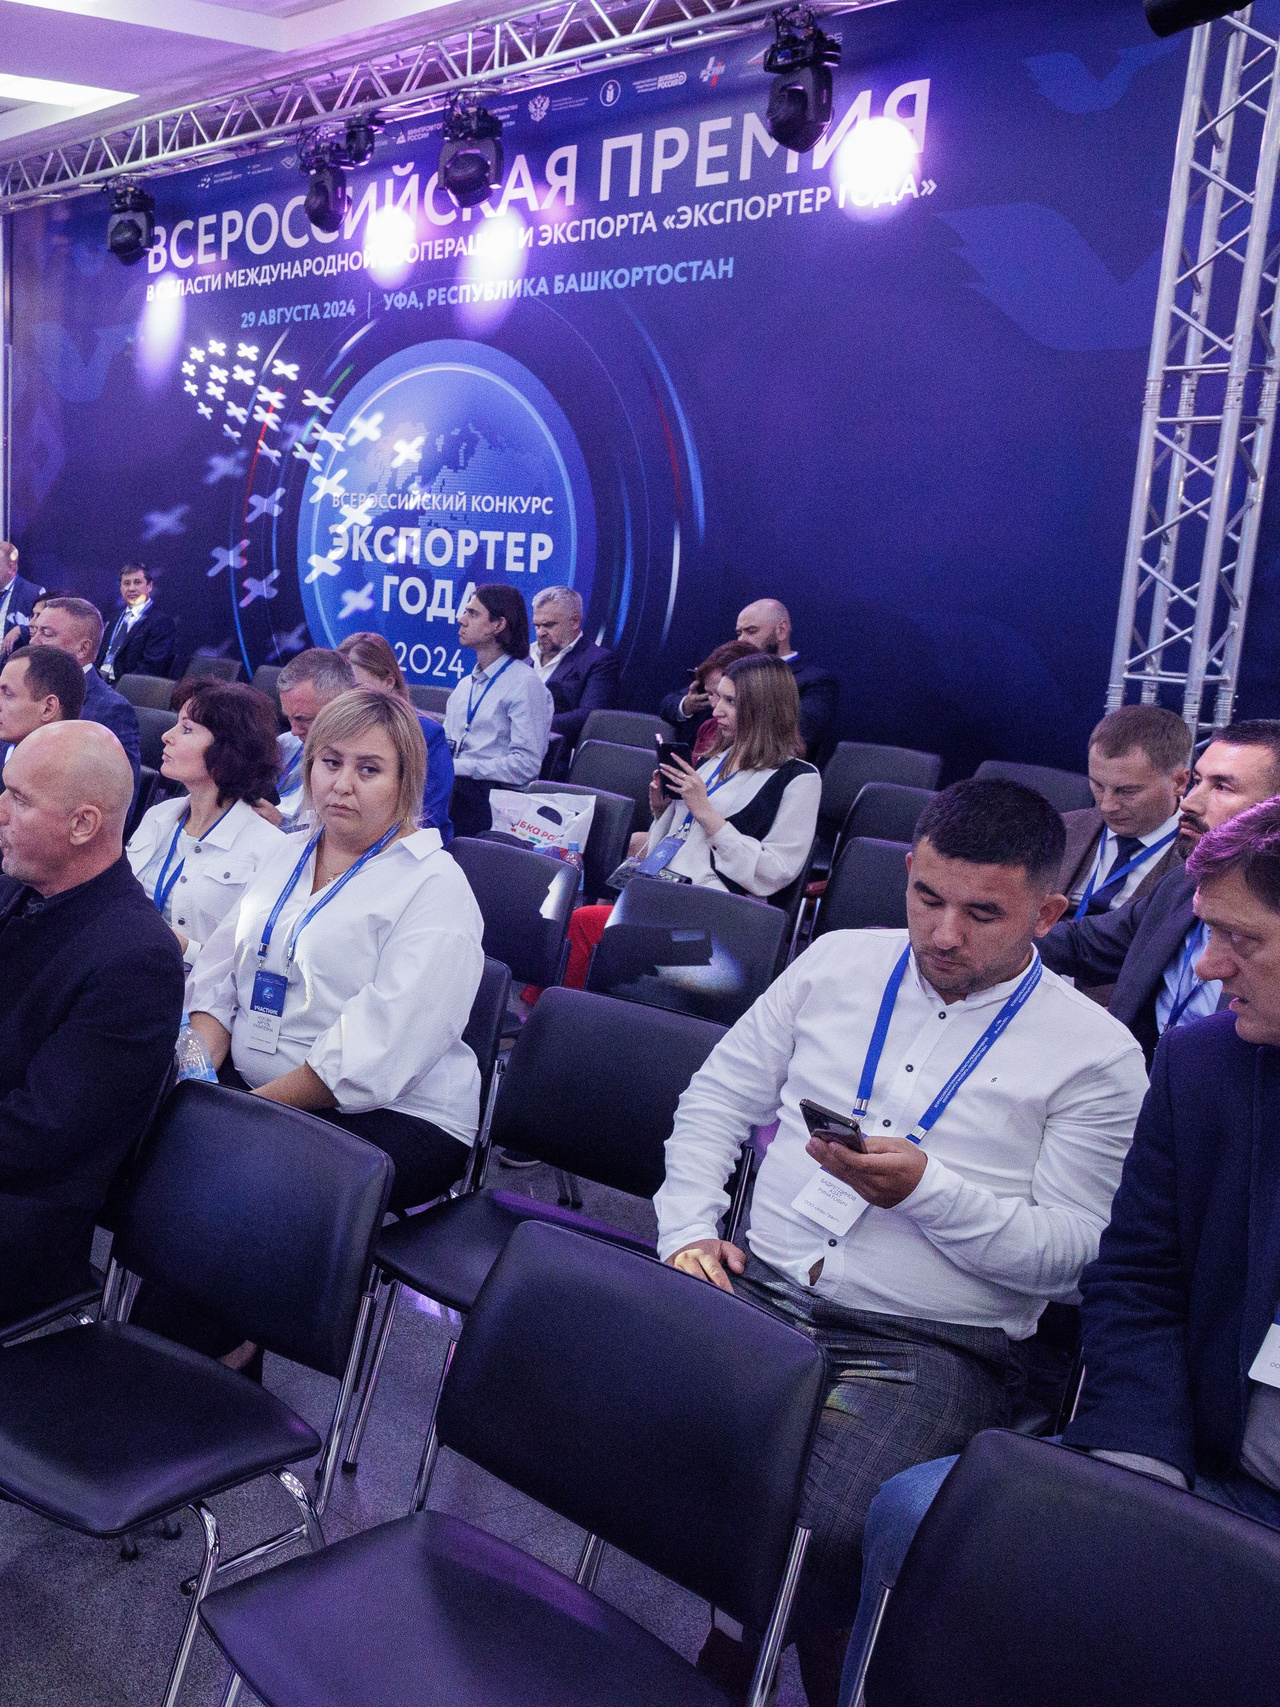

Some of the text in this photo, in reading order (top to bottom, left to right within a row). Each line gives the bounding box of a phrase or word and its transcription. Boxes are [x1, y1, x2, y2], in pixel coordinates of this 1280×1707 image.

[519, 227, 534, 250] И
[537, 211, 658, 246] ЭКСПОРТА
[662, 186, 832, 230] «ЭКСПОРТЕР
[383, 256, 735, 312] УФА, РЕСПУБЛИКА БАШКОРТОСТАН
[241, 299, 357, 329] 29 АВГУСТА 2024
[332, 490, 554, 515] ВСЕРОССИЙСКИЙ КОНКУРС
[328, 524, 554, 574] ЭКСПОРТЕР
[394, 641, 465, 680] 2024
